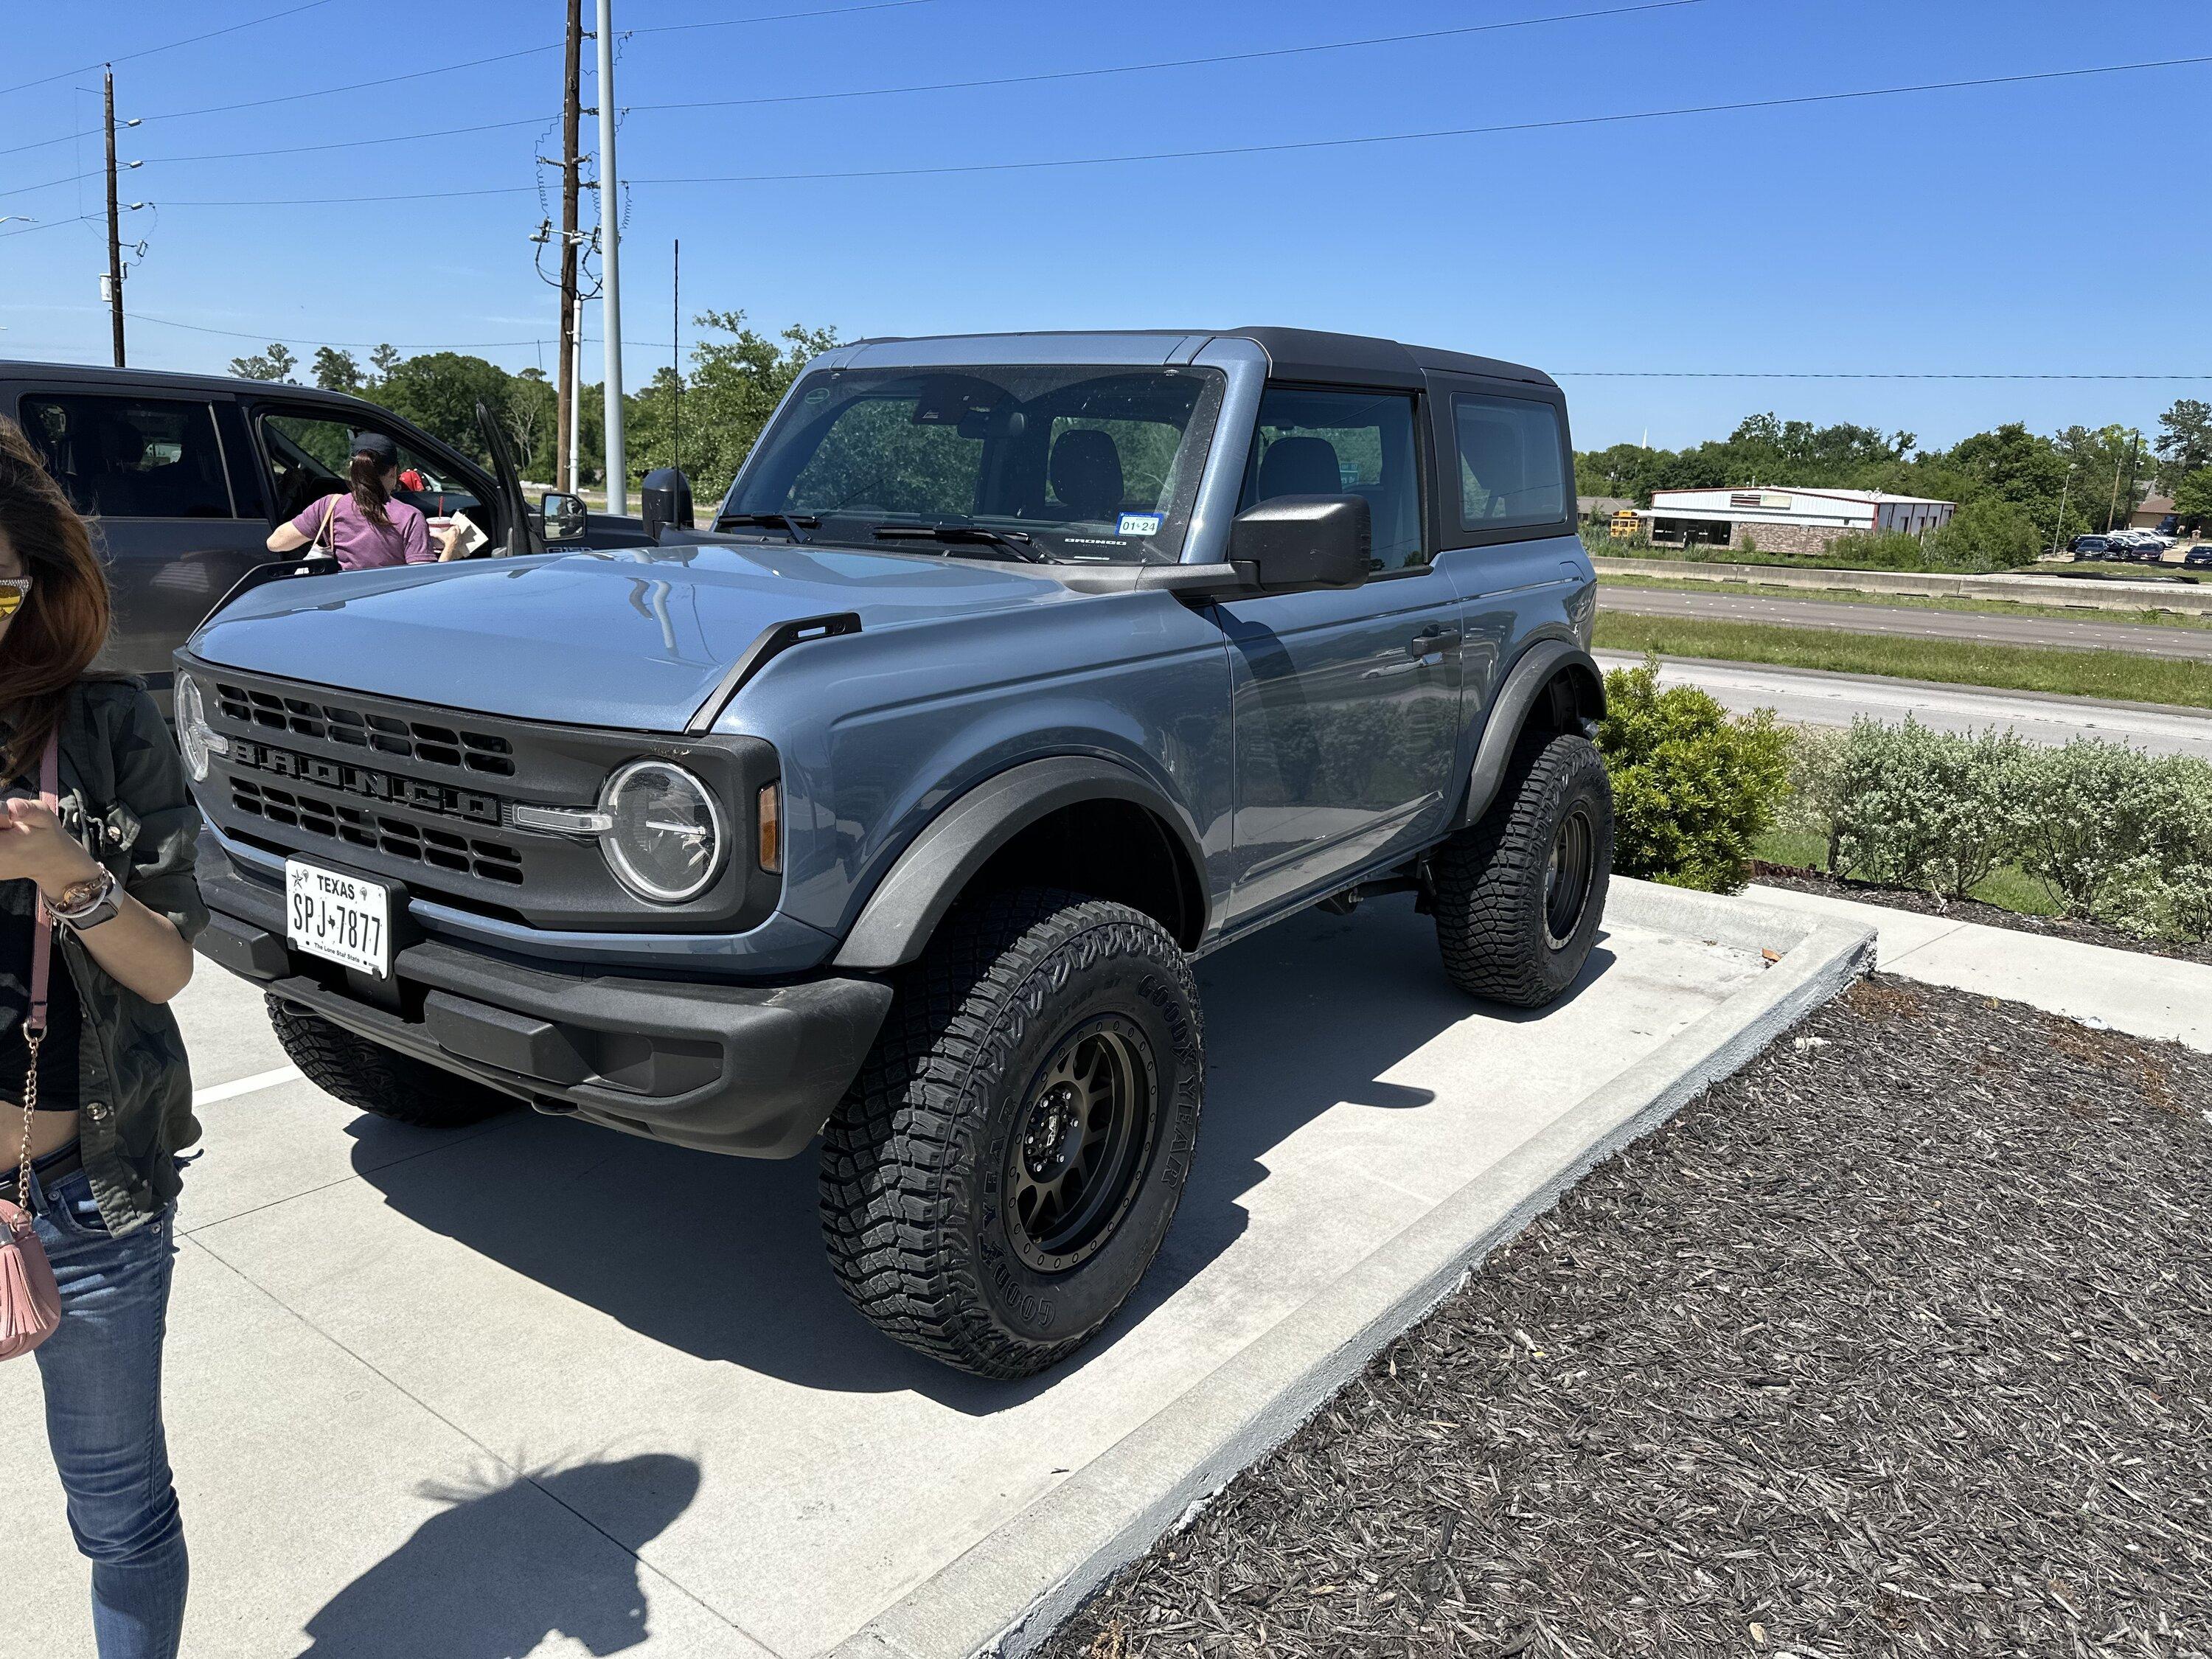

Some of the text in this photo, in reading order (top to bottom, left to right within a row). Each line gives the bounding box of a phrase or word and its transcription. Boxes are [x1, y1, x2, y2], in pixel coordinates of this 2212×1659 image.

[1122, 521, 1155, 531] 01 24
[232, 740, 501, 824] BRONCO
[316, 874, 355, 900] TEXAS
[294, 893, 380, 956] SPJ 7877
[314, 942, 360, 963] The Lone Star State
[1046, 1114, 1054, 1147] DV8
